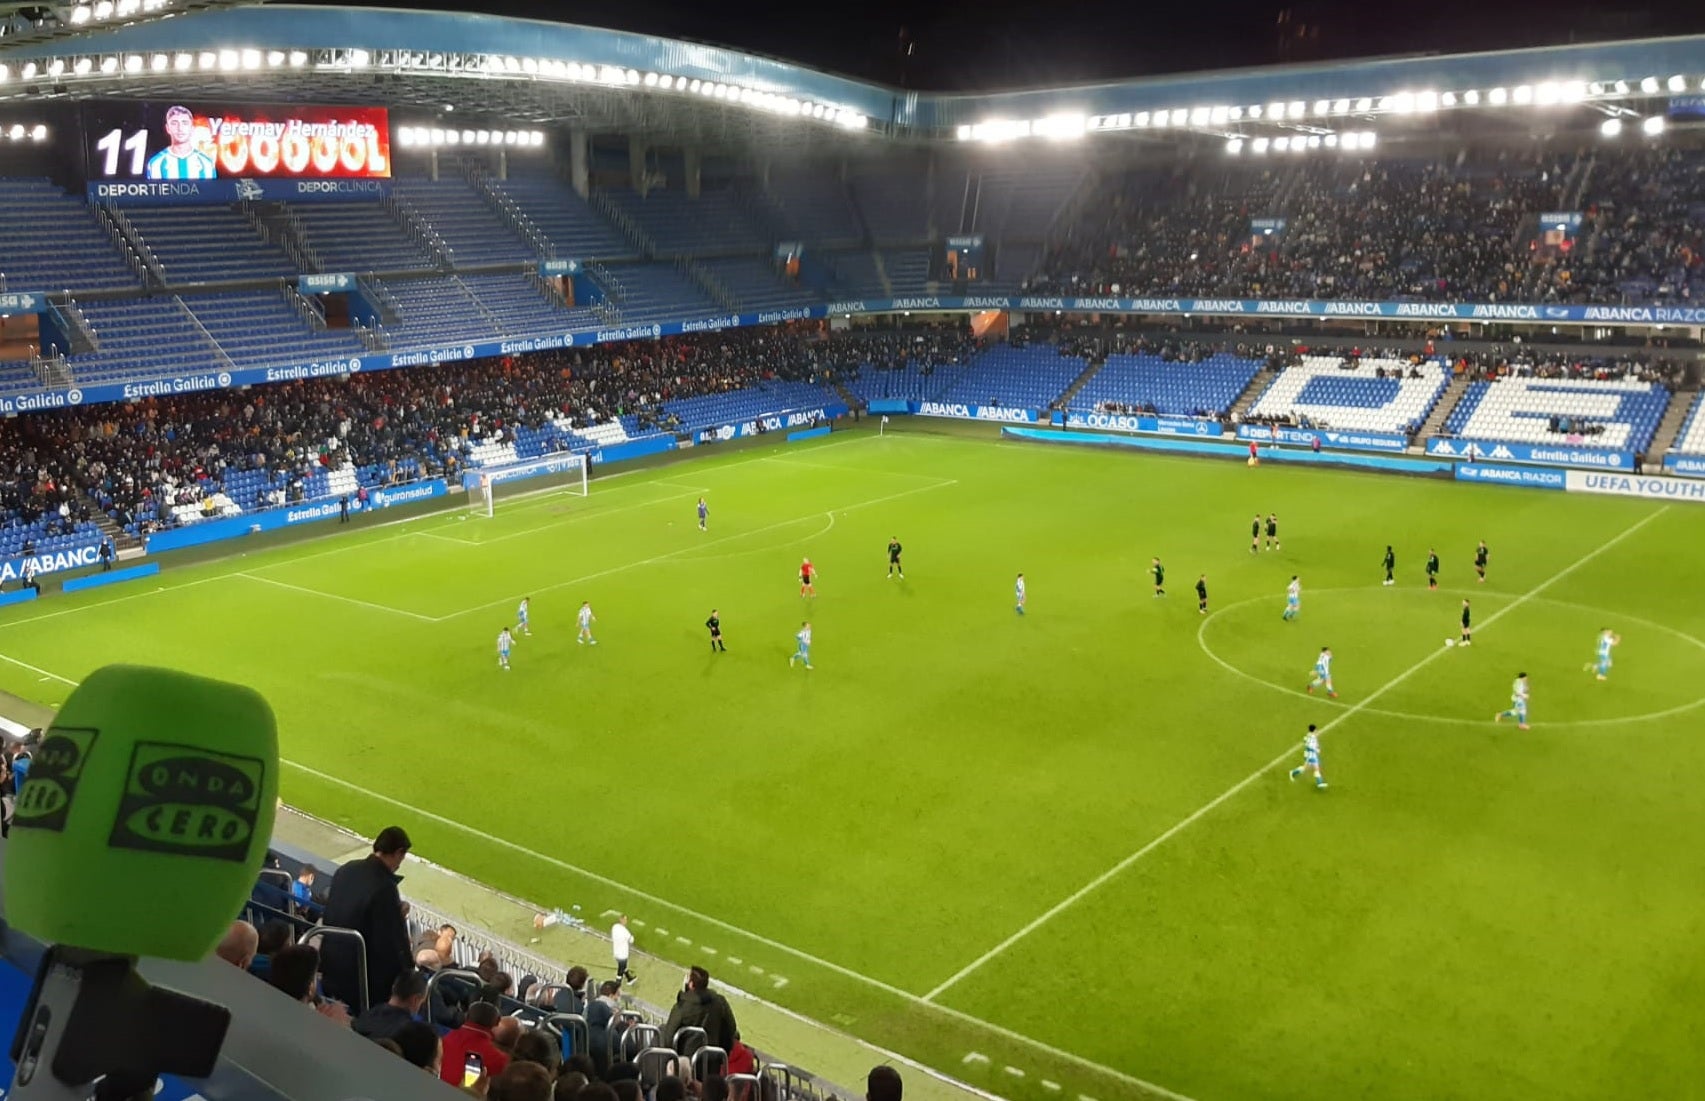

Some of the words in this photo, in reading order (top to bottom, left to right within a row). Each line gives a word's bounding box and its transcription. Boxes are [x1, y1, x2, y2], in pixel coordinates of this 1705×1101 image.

[208, 117, 285, 141] Yeremay
[287, 119, 375, 138] Hernández
[97, 128, 148, 175] 11
[98, 183, 200, 197] DEPORTIENDA
[501, 342, 533, 354] Estrella
[534, 338, 563, 351] Galicia
[392, 352, 428, 367] Estrella
[430, 349, 462, 364] Galicia
[267, 365, 308, 382] Estrella
[310, 360, 347, 376] Galicia
[124, 381, 171, 398] Estrella
[173, 375, 216, 392] Galicia
[16, 393, 64, 411] Galicia
[1087, 414, 1138, 429] OCASO
[1531, 448, 1569, 462] Estrella
[1570, 451, 1606, 465] Galicia
[1523, 470, 1562, 483] RIAZOR
[1585, 475, 1632, 491] UEFA
[1636, 479, 1705, 497] YOUTH
[288, 505, 320, 522] Estrella
[151, 767, 244, 794] ONDA
[18, 784, 59, 810] ERO
[145, 805, 238, 841] CERO
